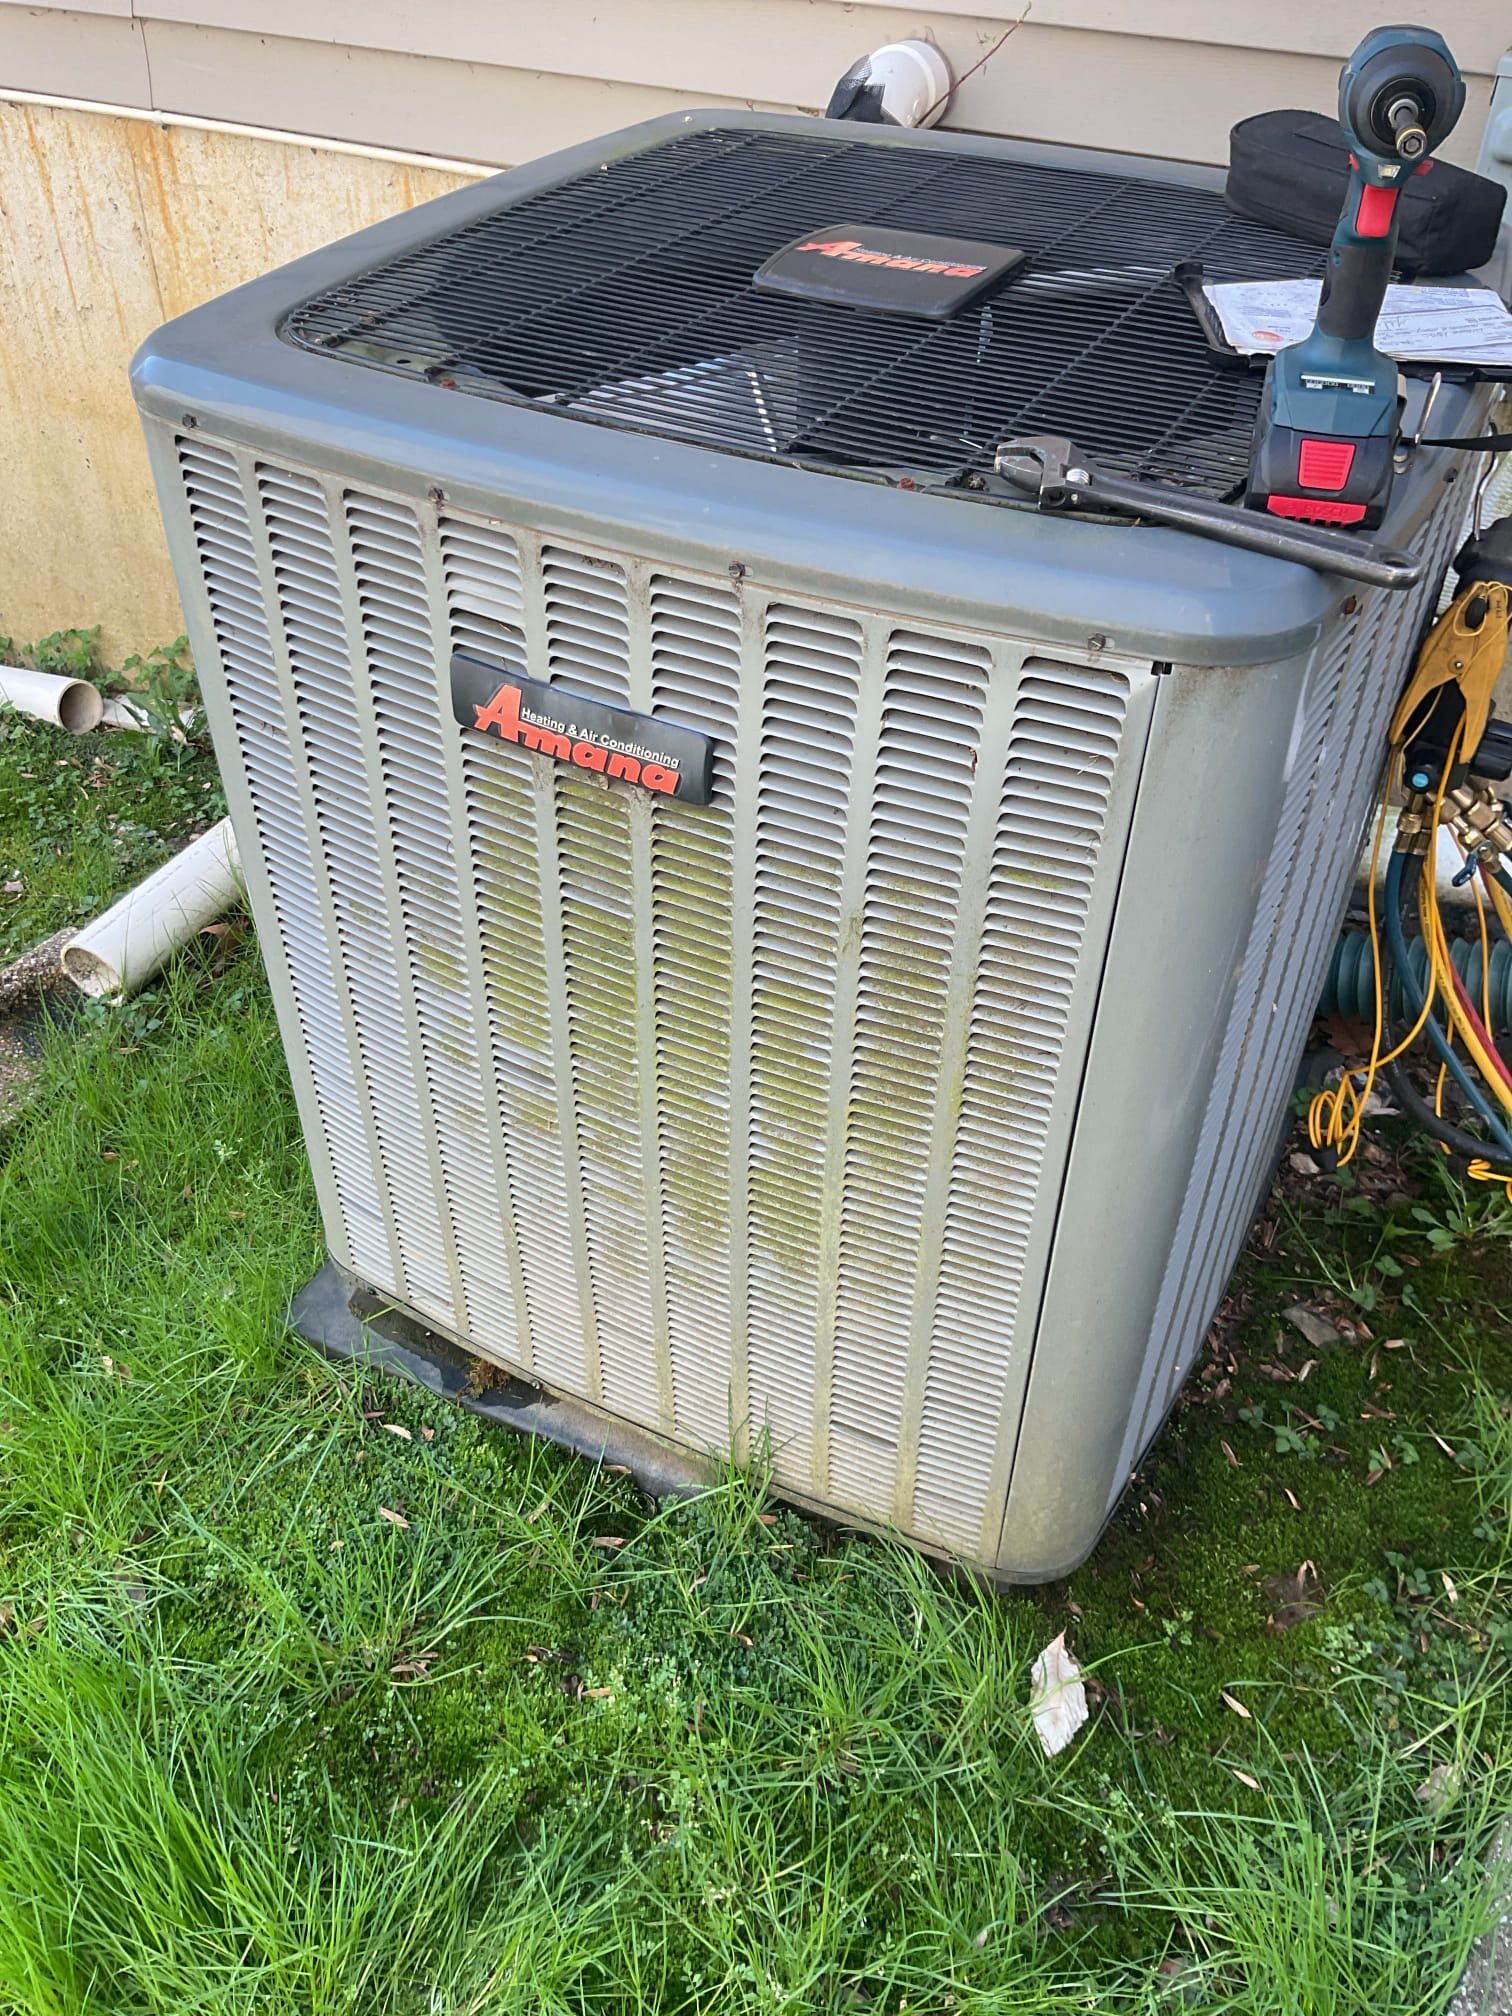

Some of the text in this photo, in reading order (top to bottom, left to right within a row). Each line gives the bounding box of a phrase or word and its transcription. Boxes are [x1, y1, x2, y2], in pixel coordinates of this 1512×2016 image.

[796, 241, 985, 277] Amana
[473, 683, 680, 795] Amana
[522, 707, 680, 769] Heating & Air Conditioning
